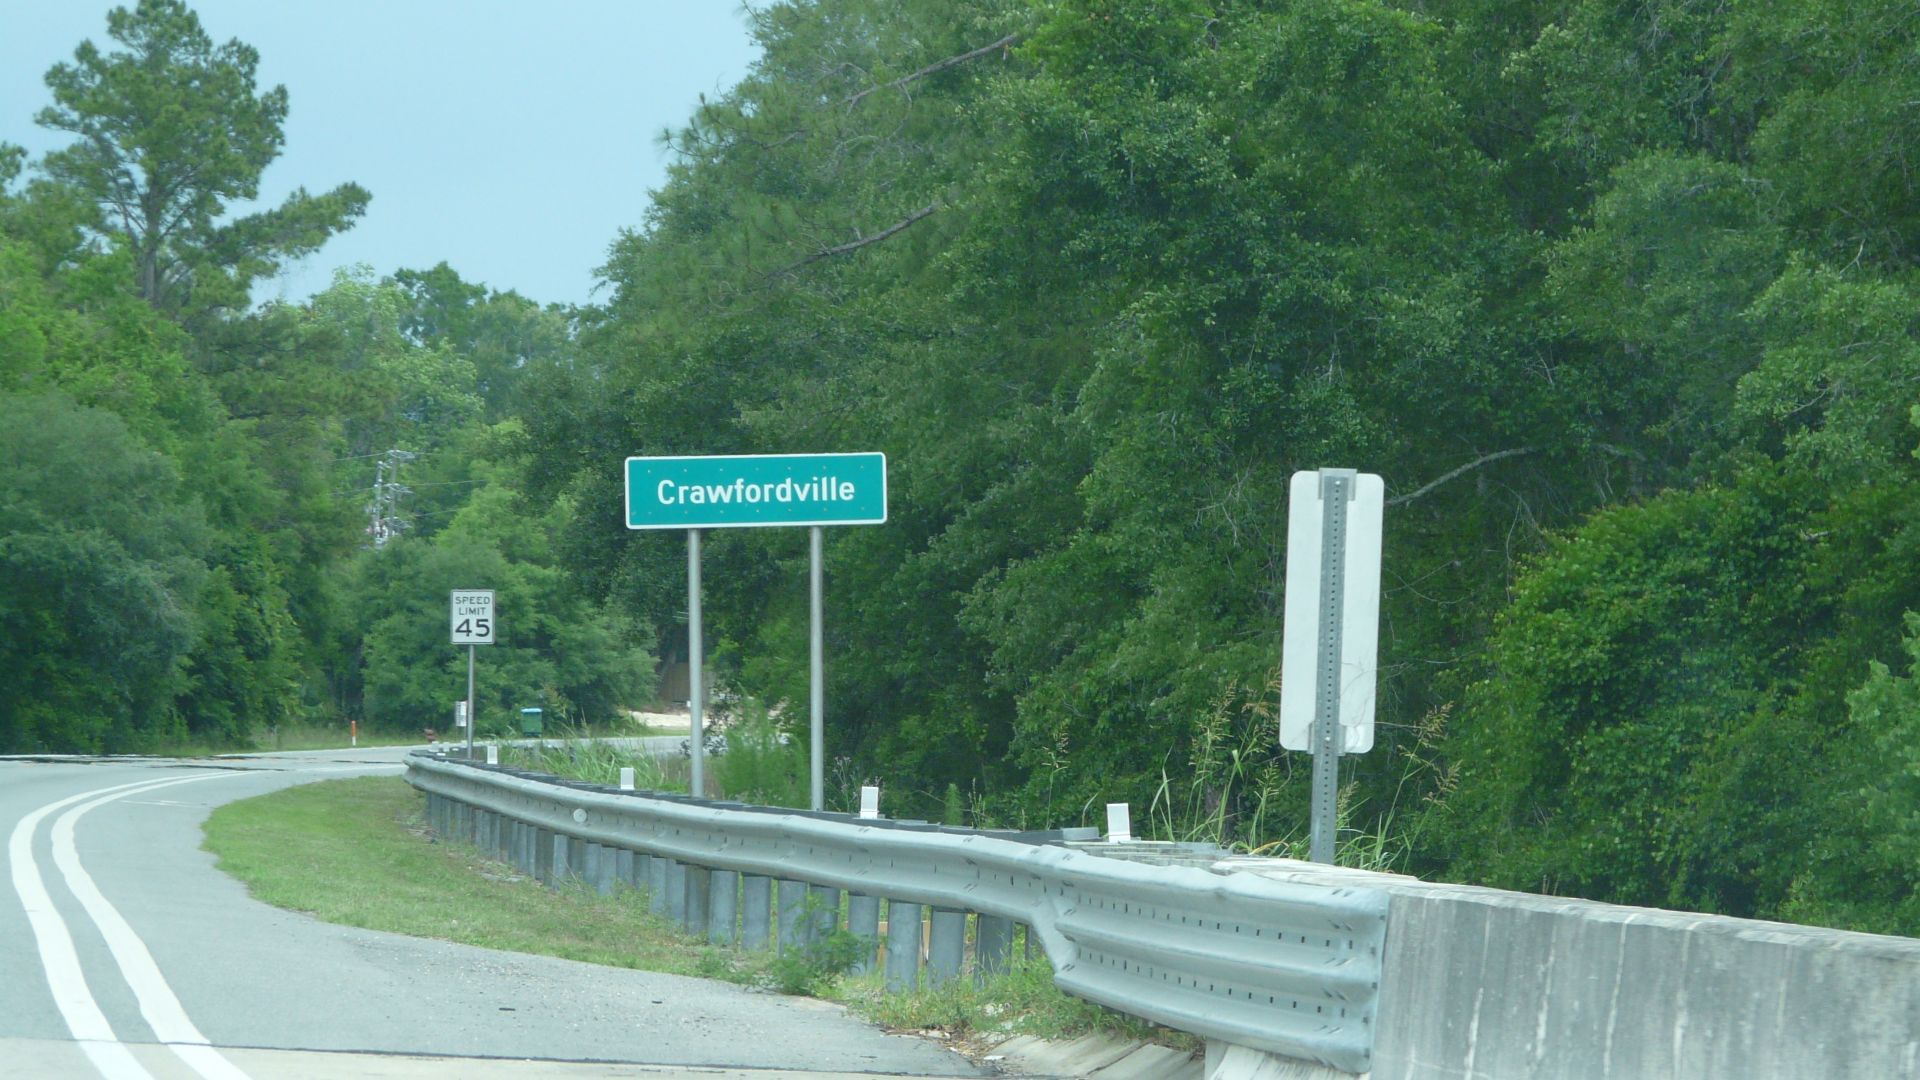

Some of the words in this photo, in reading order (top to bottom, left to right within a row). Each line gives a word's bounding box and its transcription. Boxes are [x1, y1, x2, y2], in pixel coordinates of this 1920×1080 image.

[657, 476, 855, 505] Crawfordville
[455, 596, 490, 604] SPEED
[459, 607, 486, 616] LIMIT
[455, 618, 490, 637] 45
